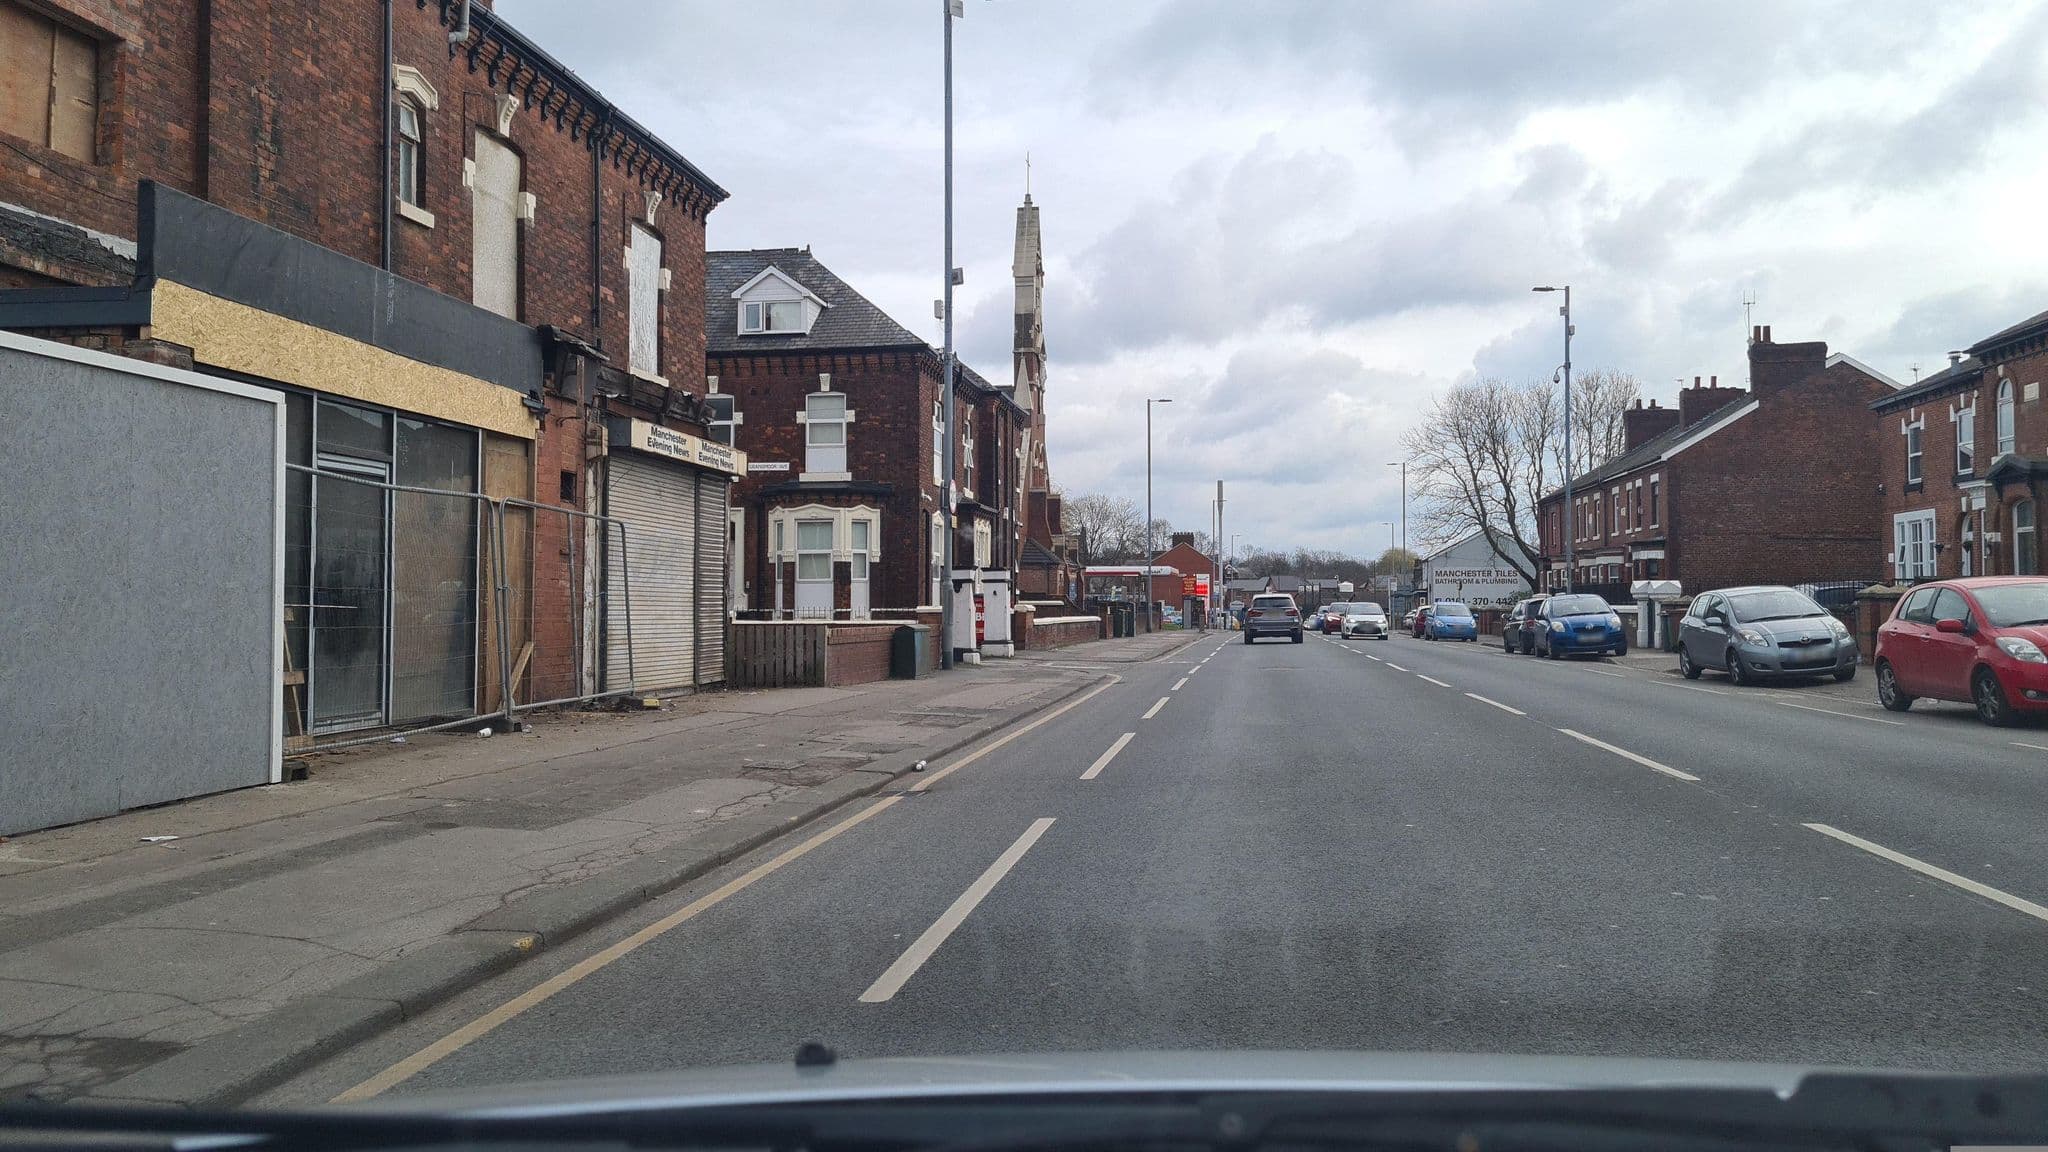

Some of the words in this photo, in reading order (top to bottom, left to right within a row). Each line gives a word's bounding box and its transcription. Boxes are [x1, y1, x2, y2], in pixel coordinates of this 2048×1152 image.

[650, 426, 687, 445] Manchester
[647, 437, 672, 455] Evening
[673, 445, 690, 458] News
[701, 441, 732, 459] Manchester
[698, 452, 719, 469] Evening
[719, 458, 734, 470] News
[1472, 597, 1489, 605] 370
